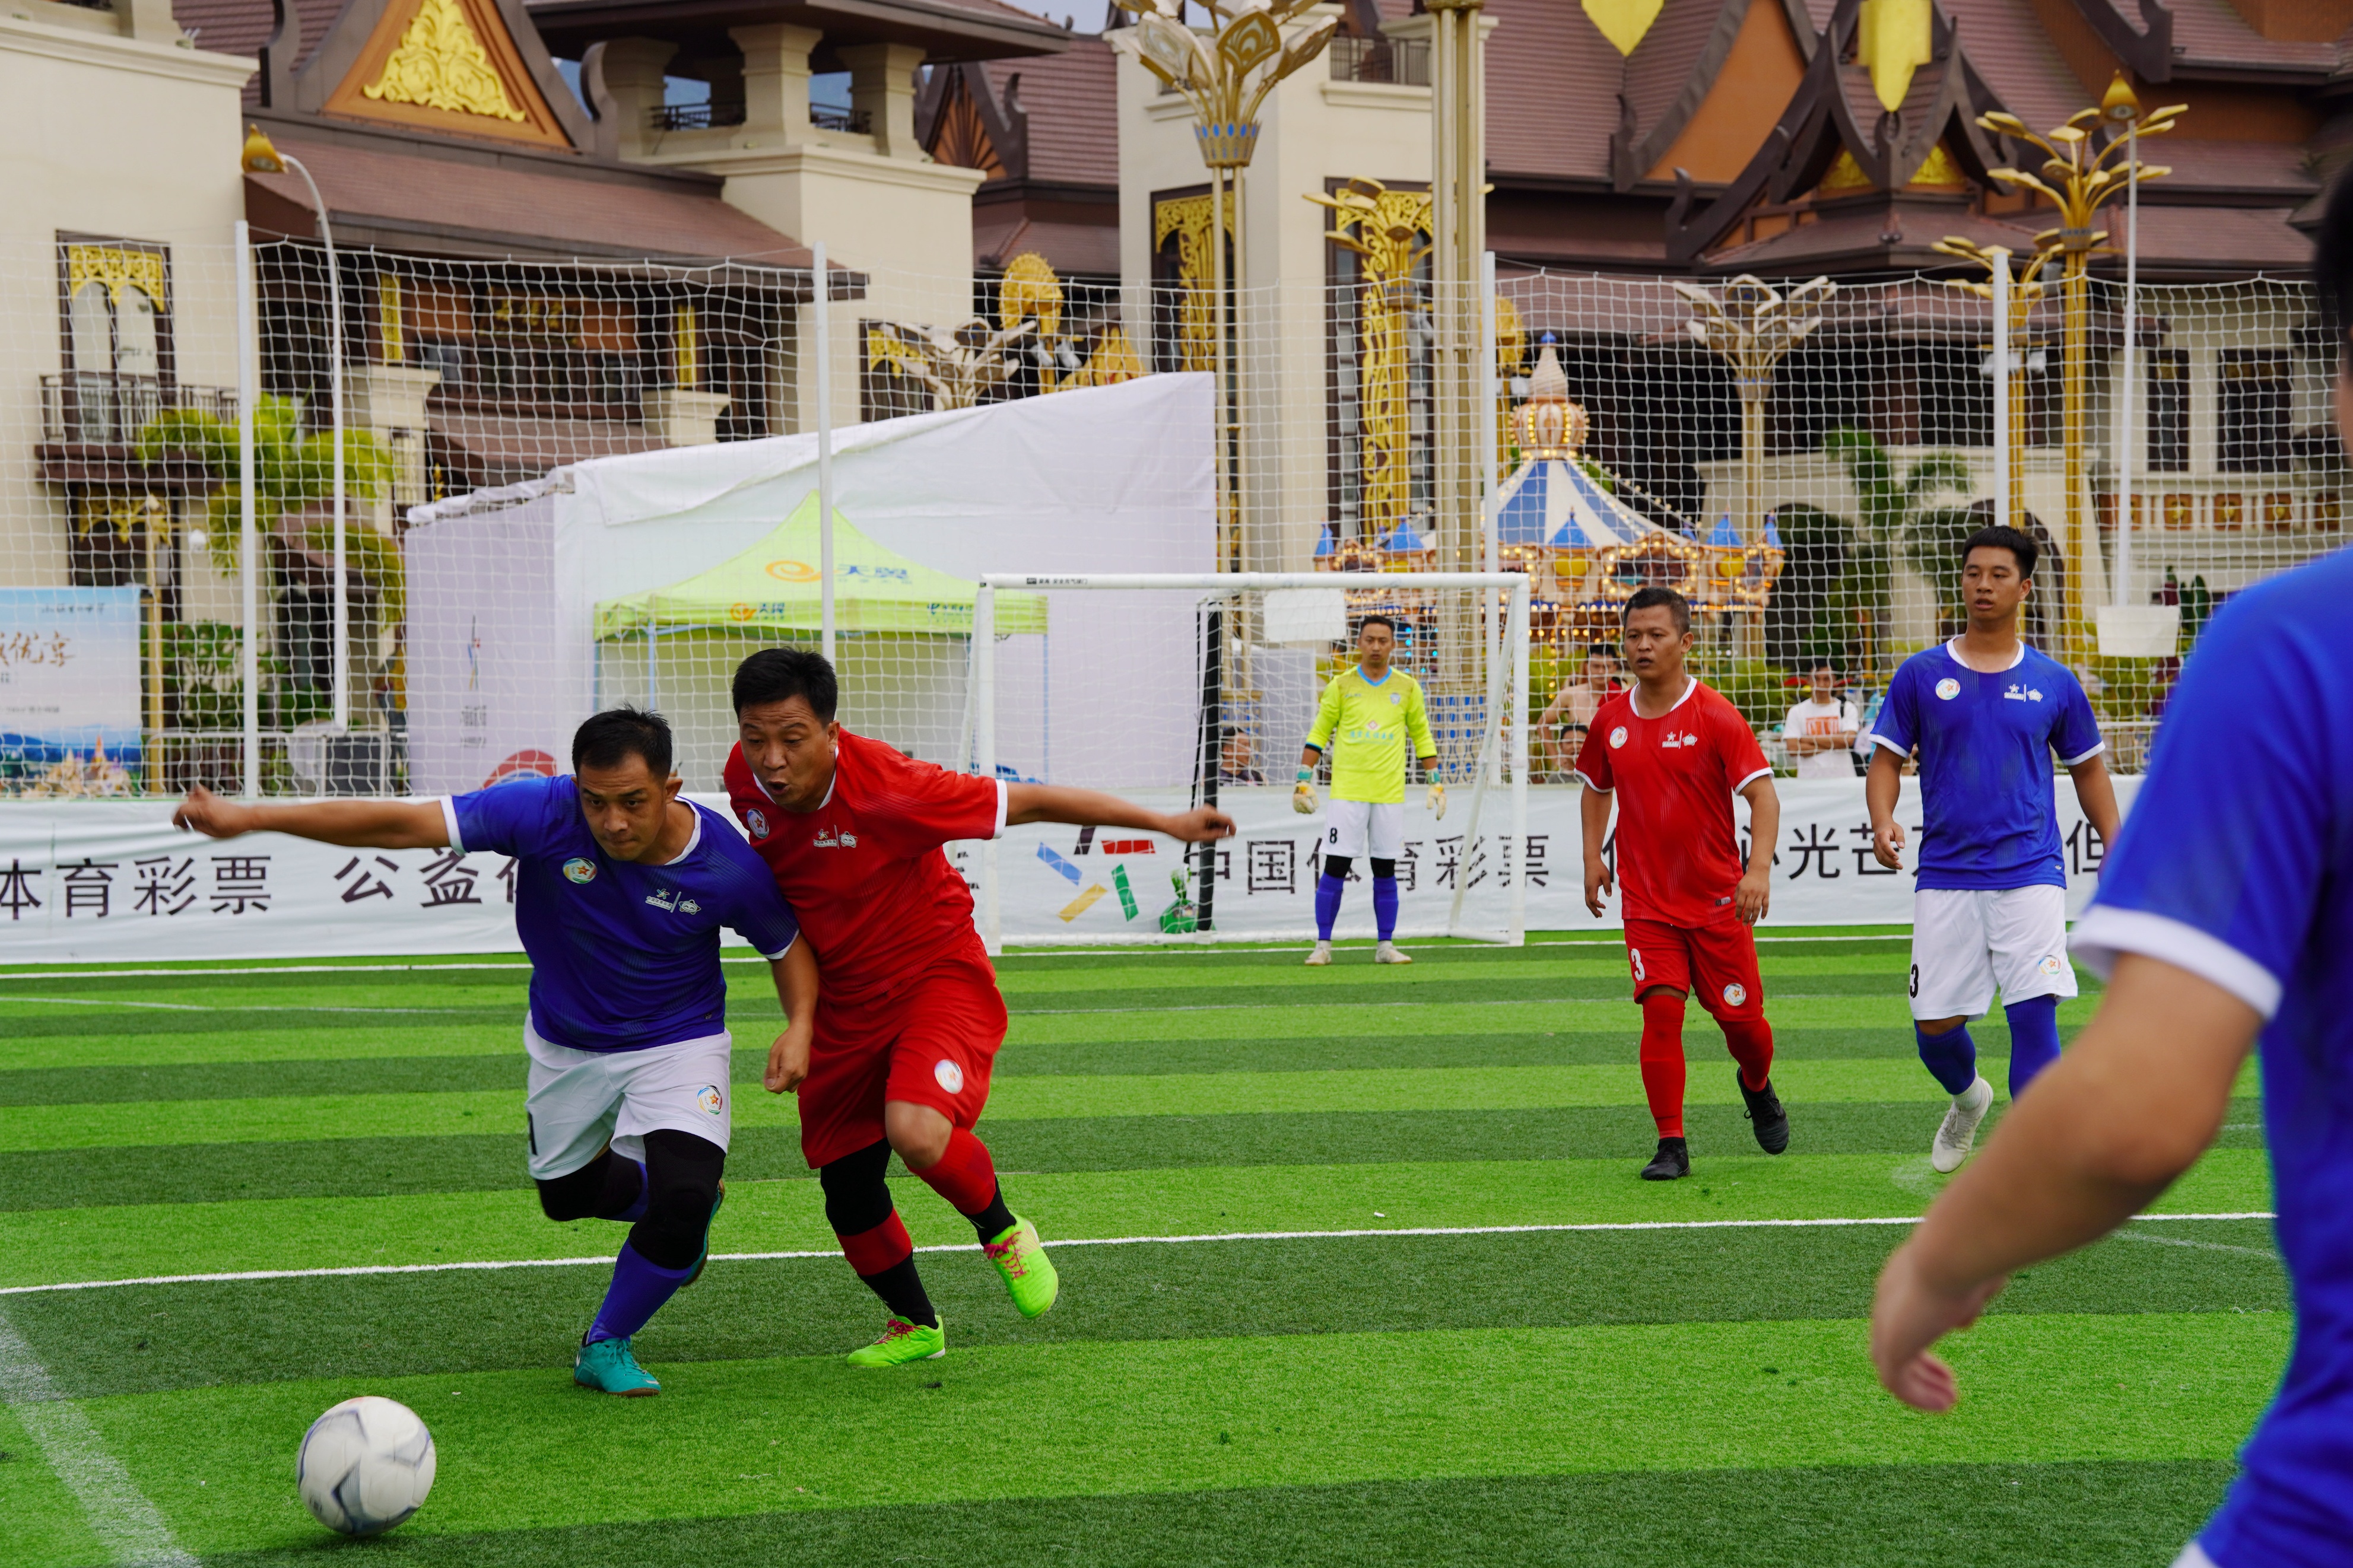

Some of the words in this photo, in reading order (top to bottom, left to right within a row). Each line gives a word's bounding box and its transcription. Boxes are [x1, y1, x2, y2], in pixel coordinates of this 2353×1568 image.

[1330, 828, 1338, 844] 8
[1631, 948, 1646, 981] 3
[1910, 963, 1919, 998] 3
